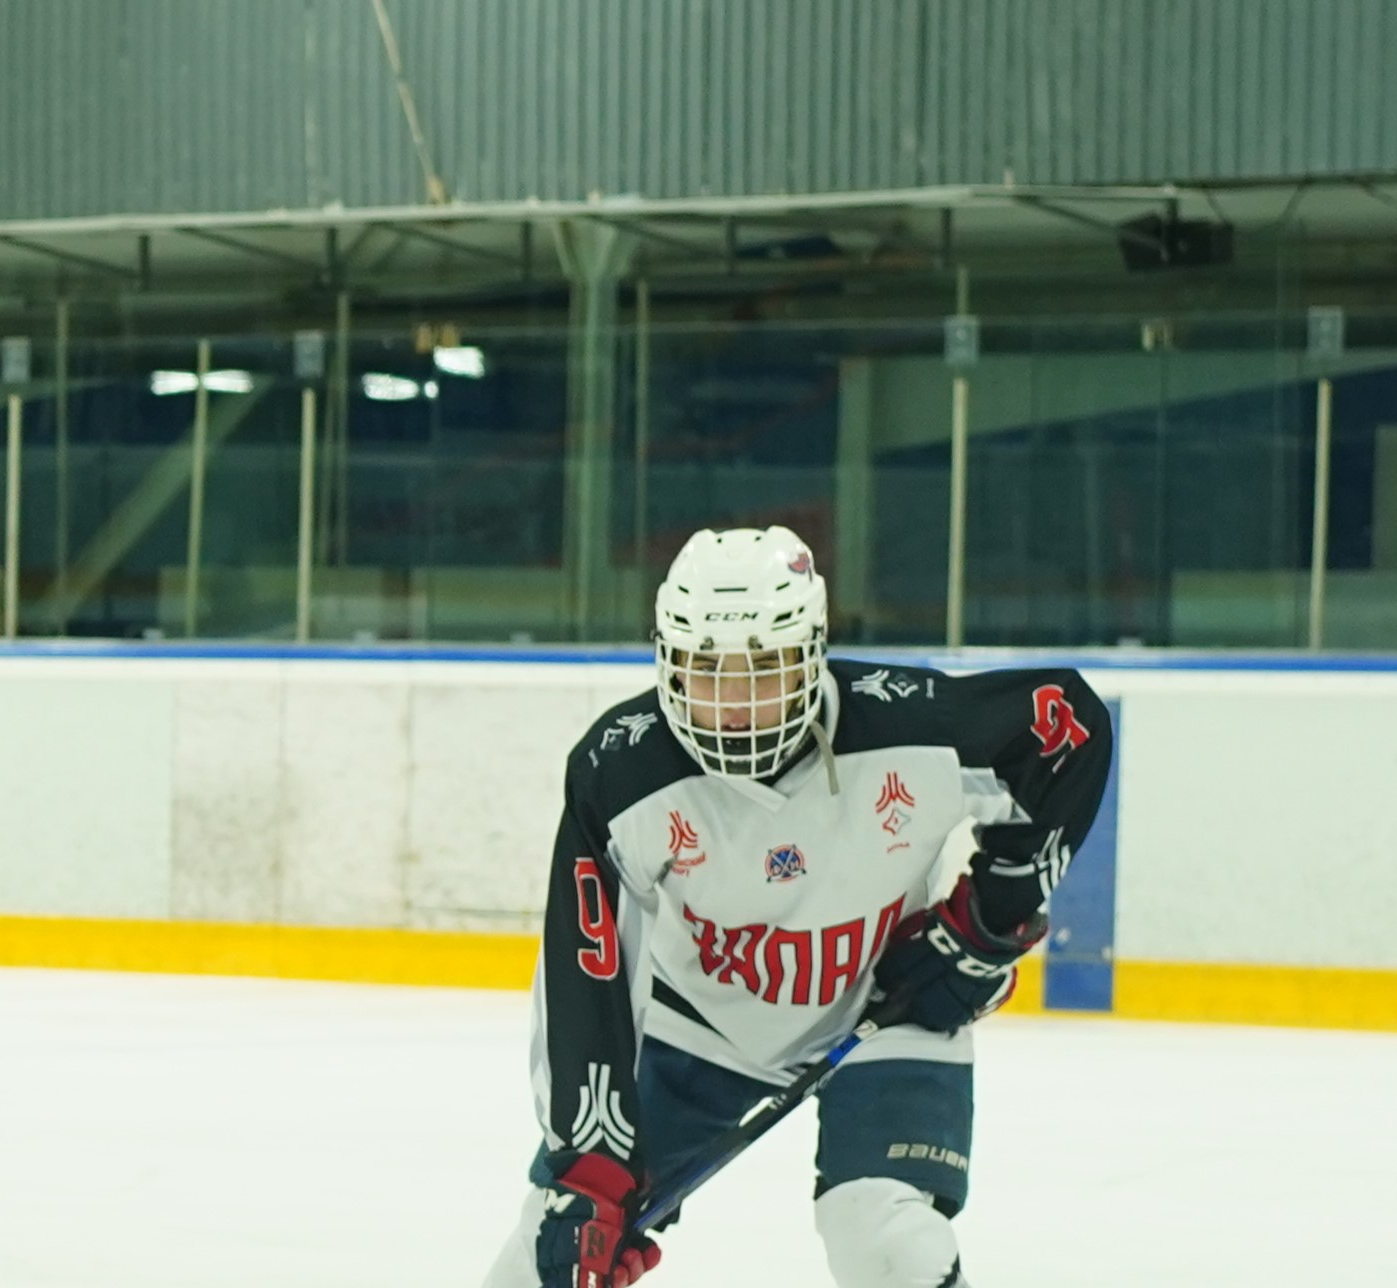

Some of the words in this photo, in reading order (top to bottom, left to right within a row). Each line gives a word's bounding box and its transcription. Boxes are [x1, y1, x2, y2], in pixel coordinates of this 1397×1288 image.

[705, 611, 758, 622] CCM
[573, 856, 621, 980] 9
[886, 1143, 968, 1173] BAUER
